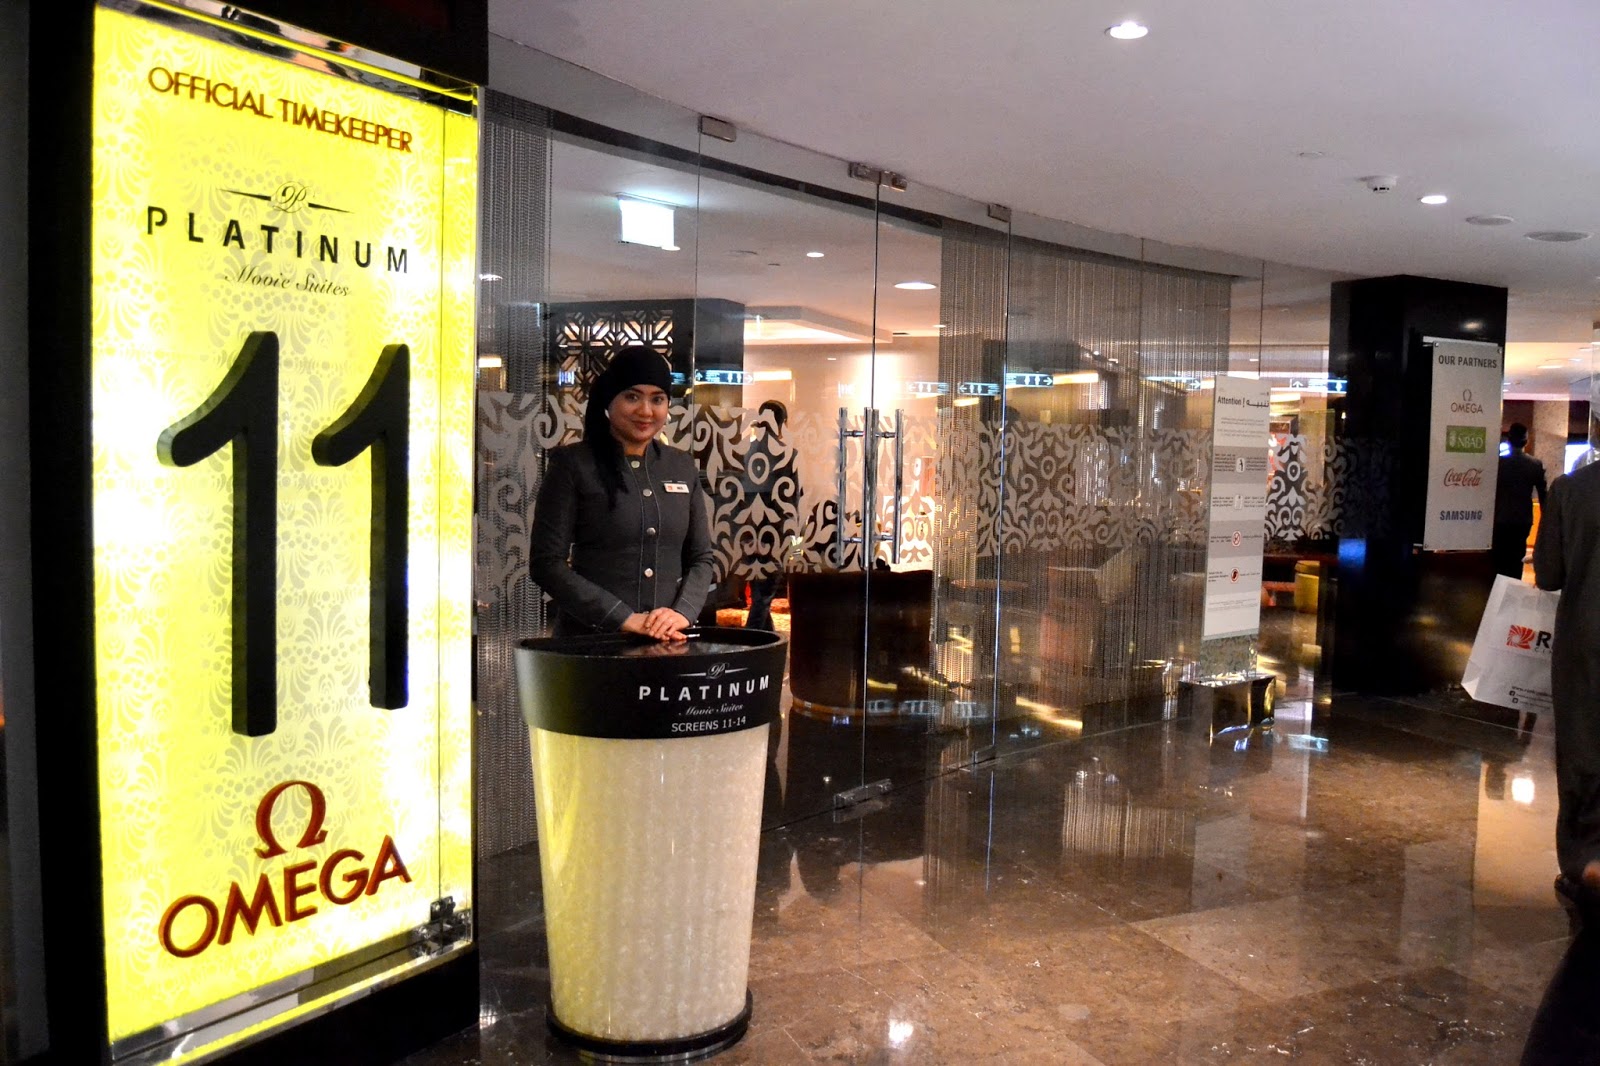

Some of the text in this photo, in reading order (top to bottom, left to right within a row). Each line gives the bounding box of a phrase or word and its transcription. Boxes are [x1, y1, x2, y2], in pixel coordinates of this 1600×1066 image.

[148, 66, 413, 153] OFFICIAL TIMEKEEPER
[147, 206, 408, 274] PLATINUM
[296, 273, 350, 297] Suites
[1438, 354, 1498, 369] OUR PARTNERS
[1217, 395, 1242, 406] Attention
[1450, 402, 1484, 414] OMEGA
[1439, 510, 1483, 521] SAMSUNG
[157, 331, 410, 737] 11
[639, 674, 769, 702] PLATINUM
[678, 702, 744, 717] Movie Suites
[671, 715, 747, 733] SCREENS 11-14
[158, 834, 412, 959] OMEGA
